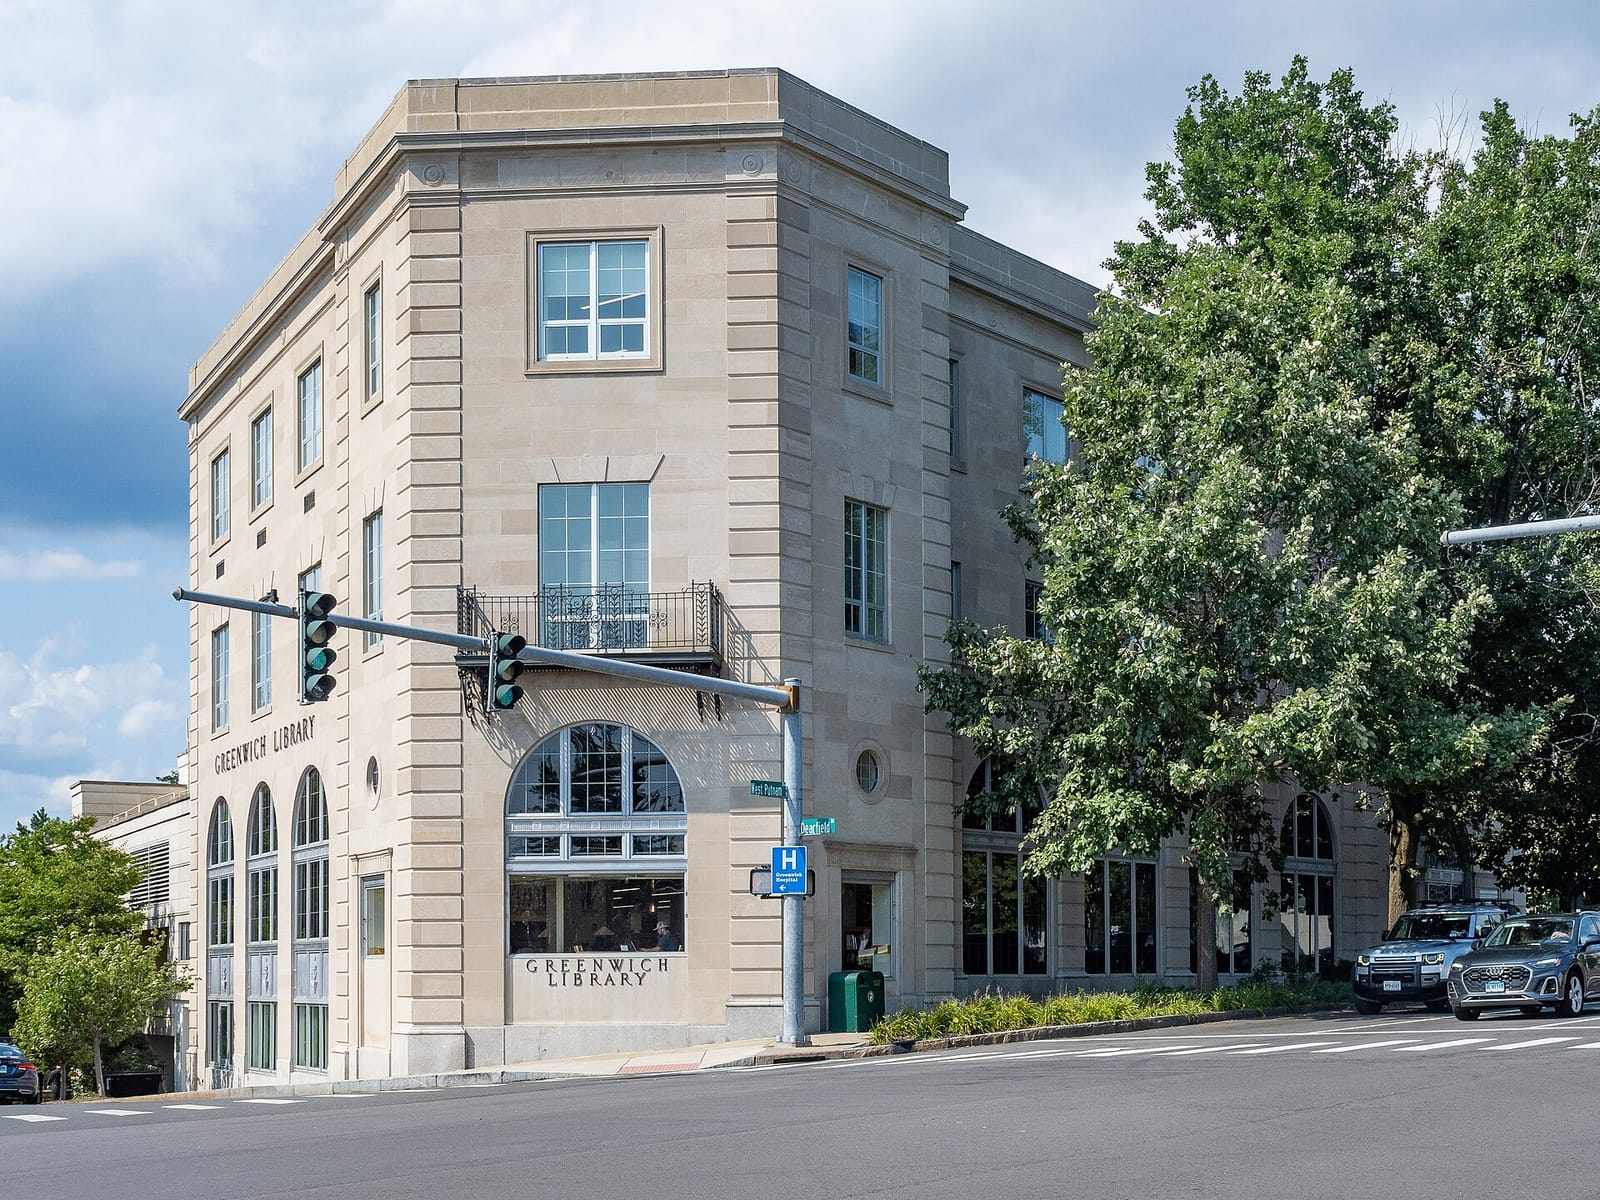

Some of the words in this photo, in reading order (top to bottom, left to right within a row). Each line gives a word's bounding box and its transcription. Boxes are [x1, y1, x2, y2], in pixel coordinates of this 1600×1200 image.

[214, 734, 267, 775] GREENWICH
[273, 714, 316, 753] LIBRARY
[751, 783, 763, 795] West
[764, 784, 783, 797] Putnam
[800, 821, 831, 835] Dearfield
[782, 849, 797, 870] H
[526, 958, 669, 973] GREENWICH
[548, 972, 647, 987] LIBRARY
